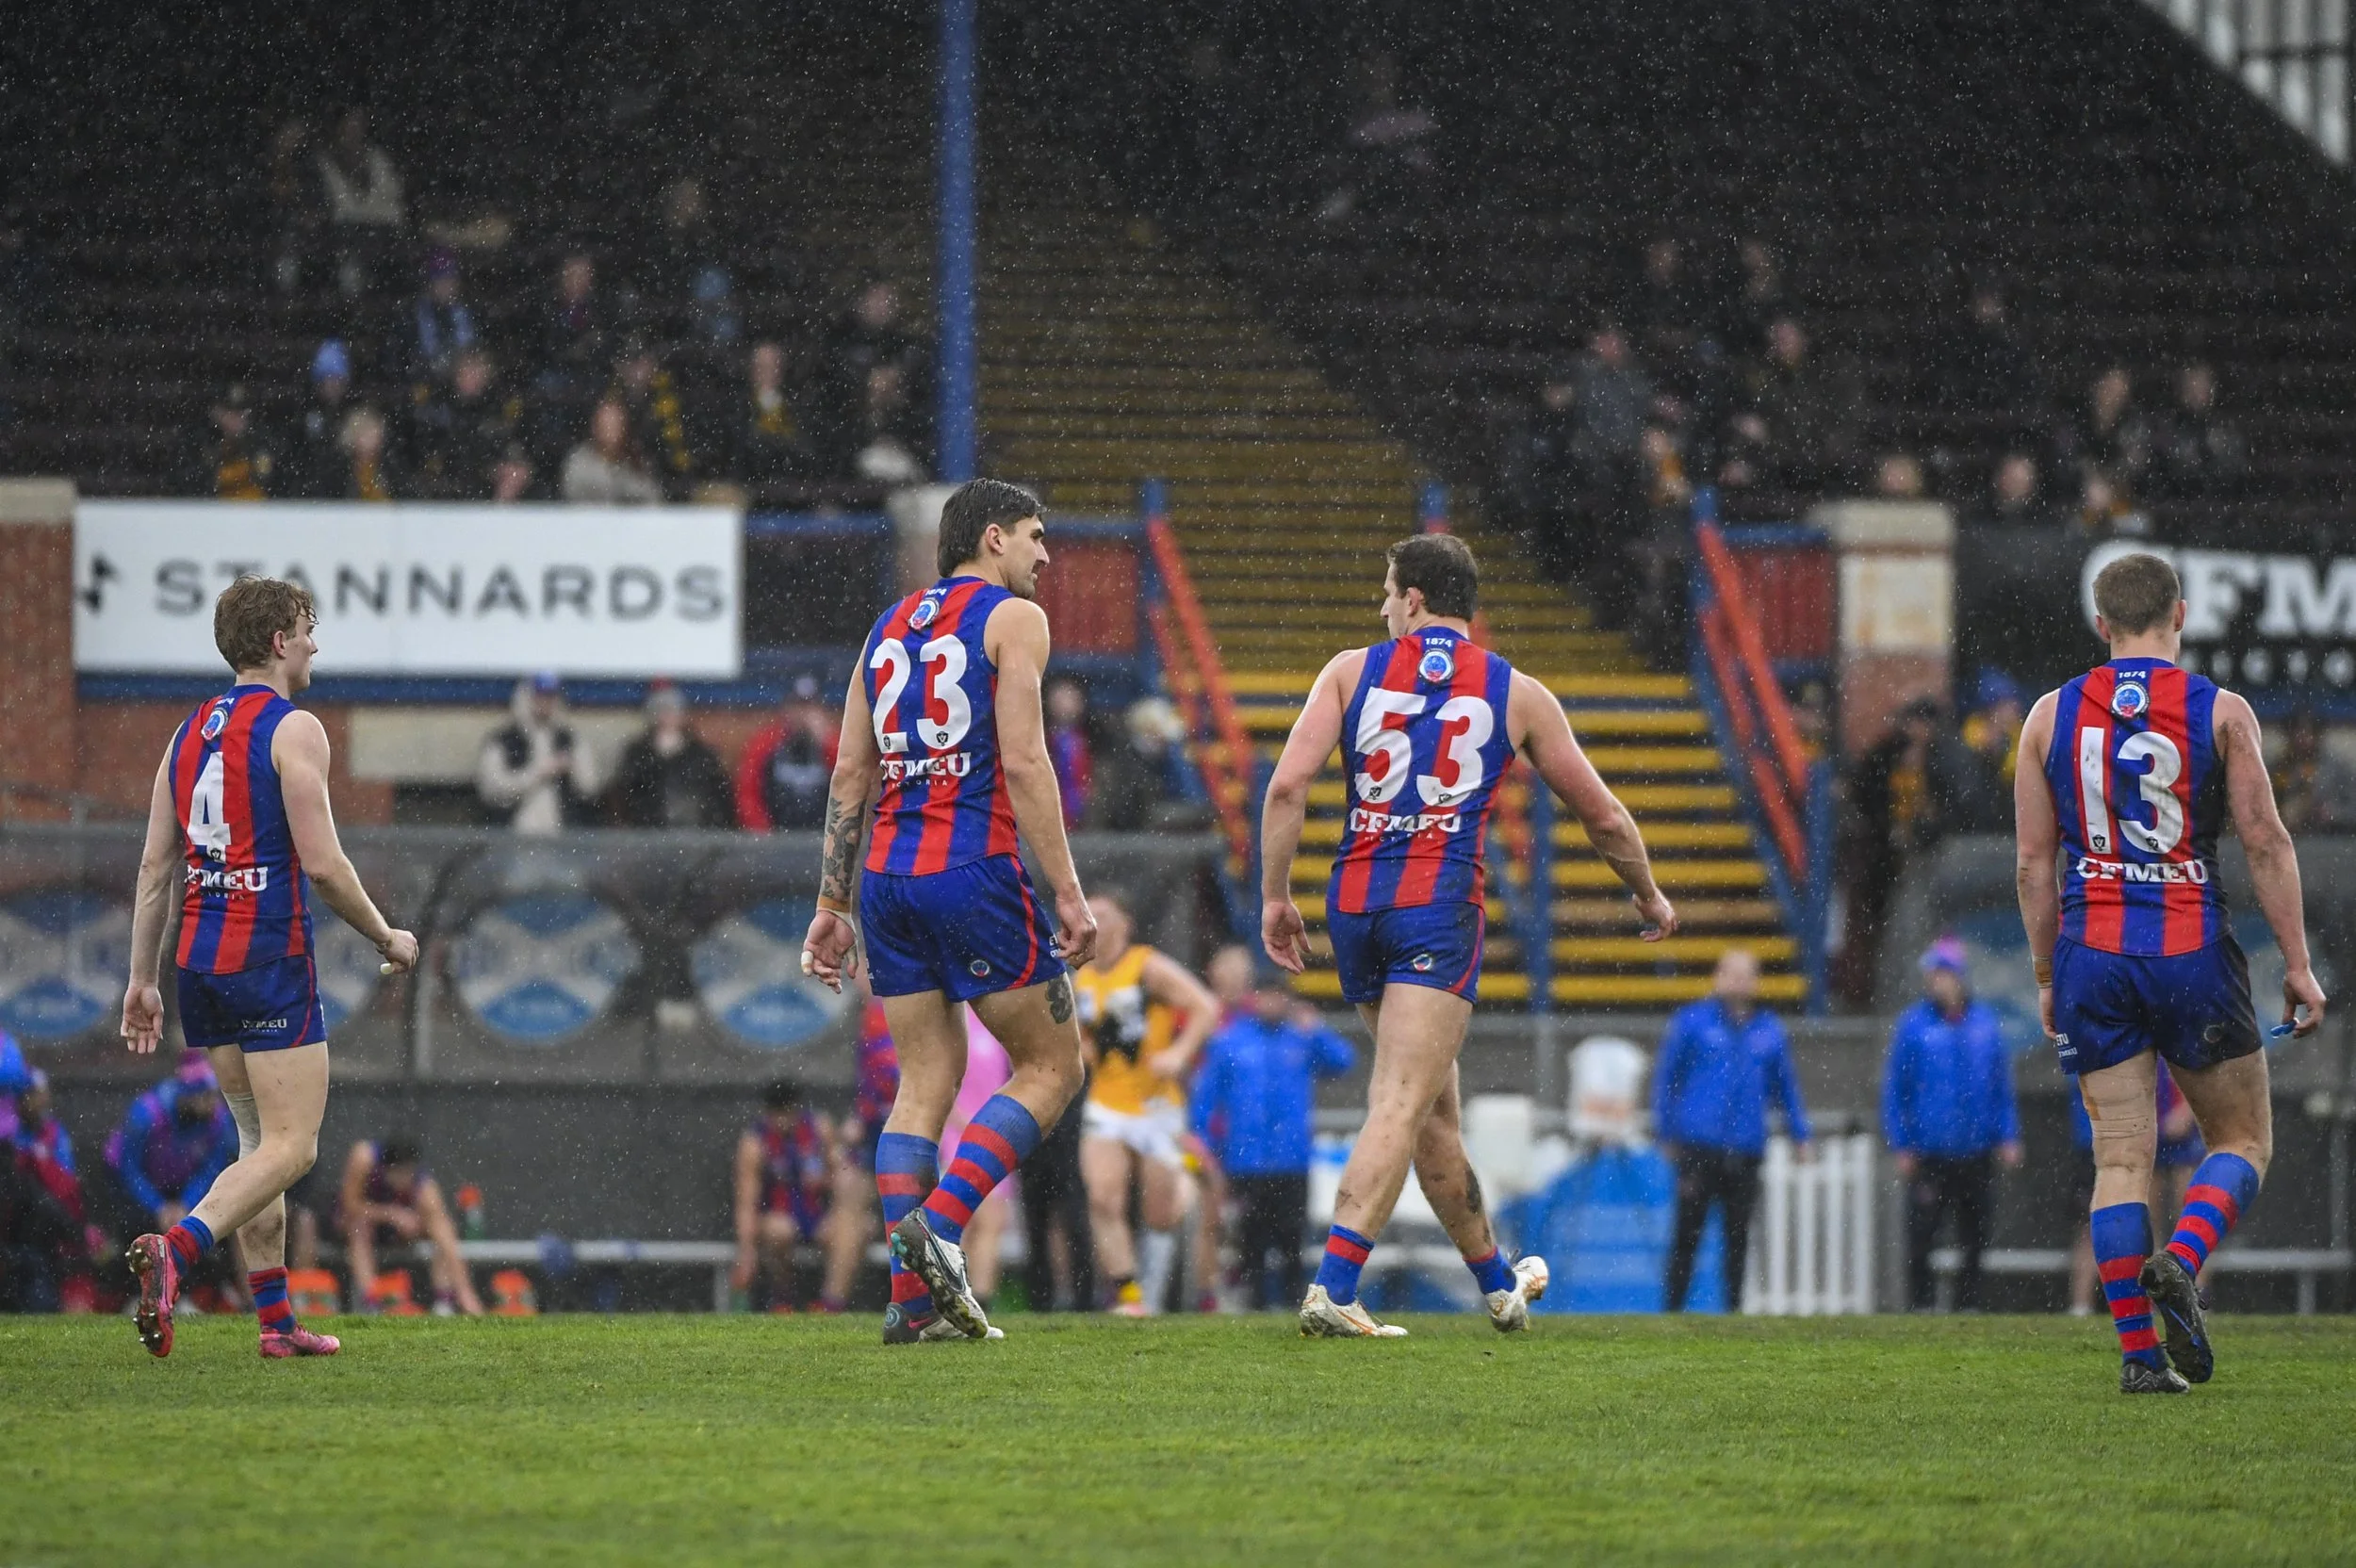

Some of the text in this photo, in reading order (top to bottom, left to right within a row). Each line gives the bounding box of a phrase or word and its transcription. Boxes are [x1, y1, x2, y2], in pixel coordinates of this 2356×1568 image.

[869, 633, 972, 753] 23
[1425, 637, 1452, 647] 1874
[1354, 686, 1494, 808] 53
[2080, 727, 2184, 855] 13
[188, 752, 232, 864] 4
[2076, 857, 2210, 884] CFMEU
